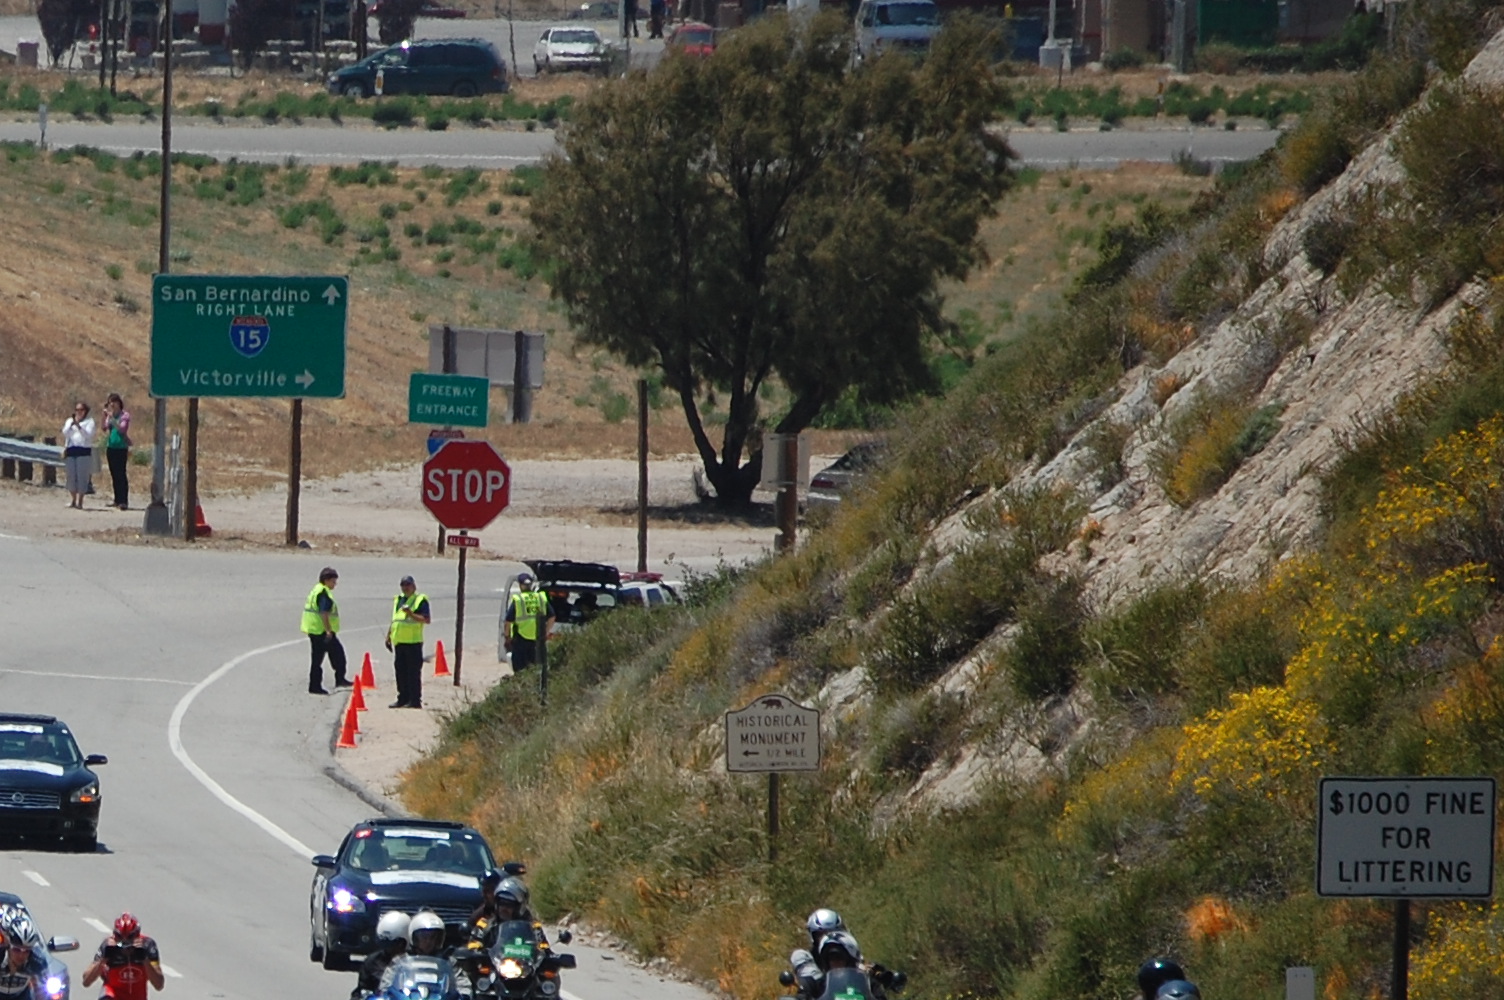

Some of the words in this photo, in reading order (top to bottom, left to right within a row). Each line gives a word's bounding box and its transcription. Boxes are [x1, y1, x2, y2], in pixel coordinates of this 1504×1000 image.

[160, 285, 197, 301] San
[205, 286, 311, 302] Bernardino
[196, 303, 246, 316] RIGHT
[254, 304, 295, 316] LANE
[238, 329, 261, 349] 15
[179, 369, 287, 387] Victorville
[422, 385, 477, 397] FREEWAY
[416, 403, 479, 417] ENTRANCE
[427, 468, 505, 503] STOP
[449, 536, 462, 545] ALL
[464, 537, 477, 546] WAY
[737, 715, 808, 728] HISTORICAL
[740, 732, 806, 745] MONUMENT
[785, 749, 806, 758] MILE
[1329, 789, 1410, 816] $1000
[1426, 792, 1485, 815] FINE
[1382, 827, 1431, 849] FOR
[1338, 861, 1472, 883] LITTERING
[504, 947, 531, 956] Photo
